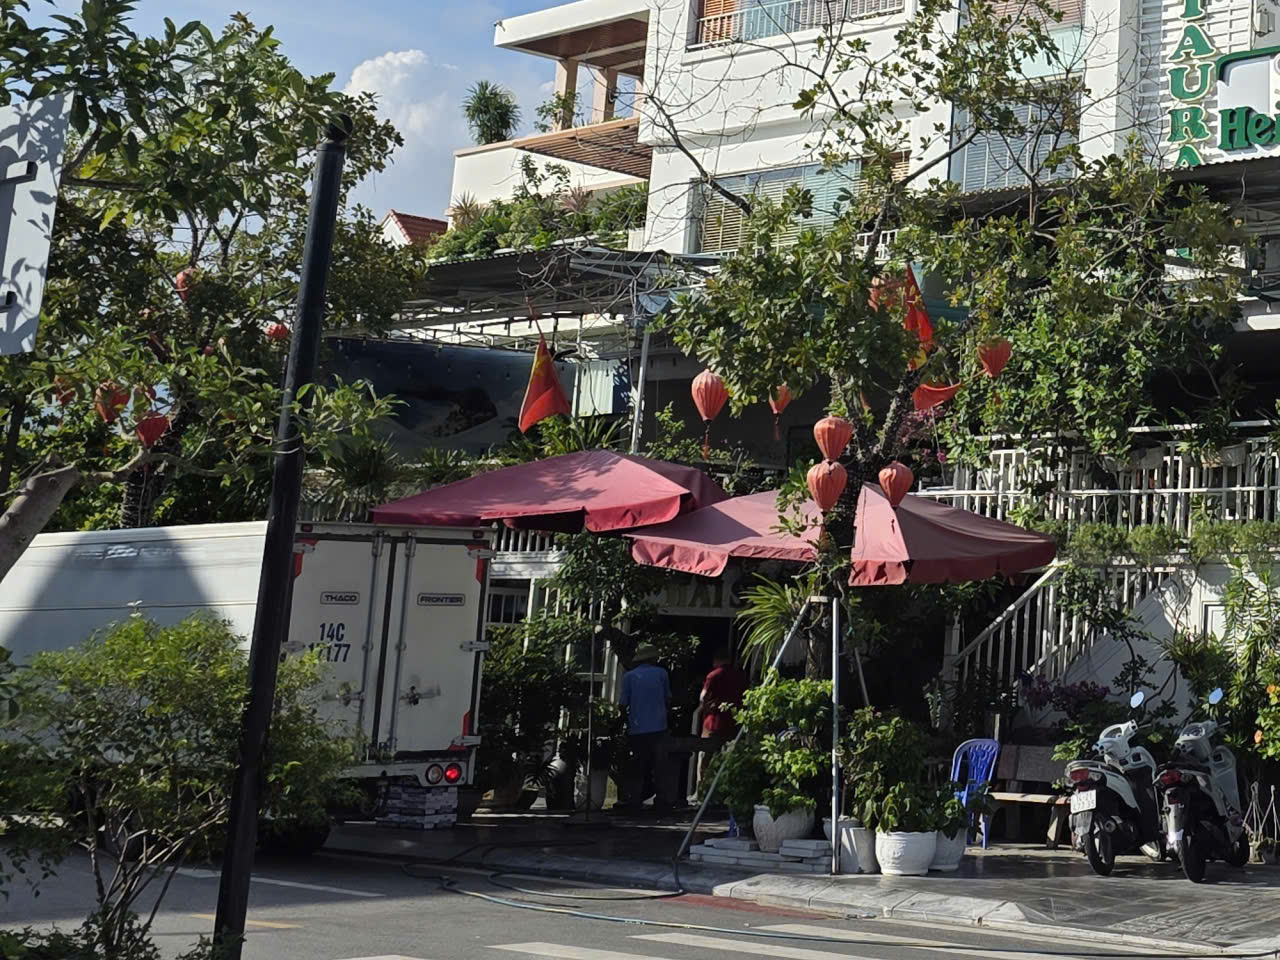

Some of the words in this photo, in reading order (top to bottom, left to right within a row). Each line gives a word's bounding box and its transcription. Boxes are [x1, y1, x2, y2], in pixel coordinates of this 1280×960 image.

[323, 594, 358, 602] THACO
[419, 595, 464, 604] FRONTIER
[319, 622, 346, 642] 14C
